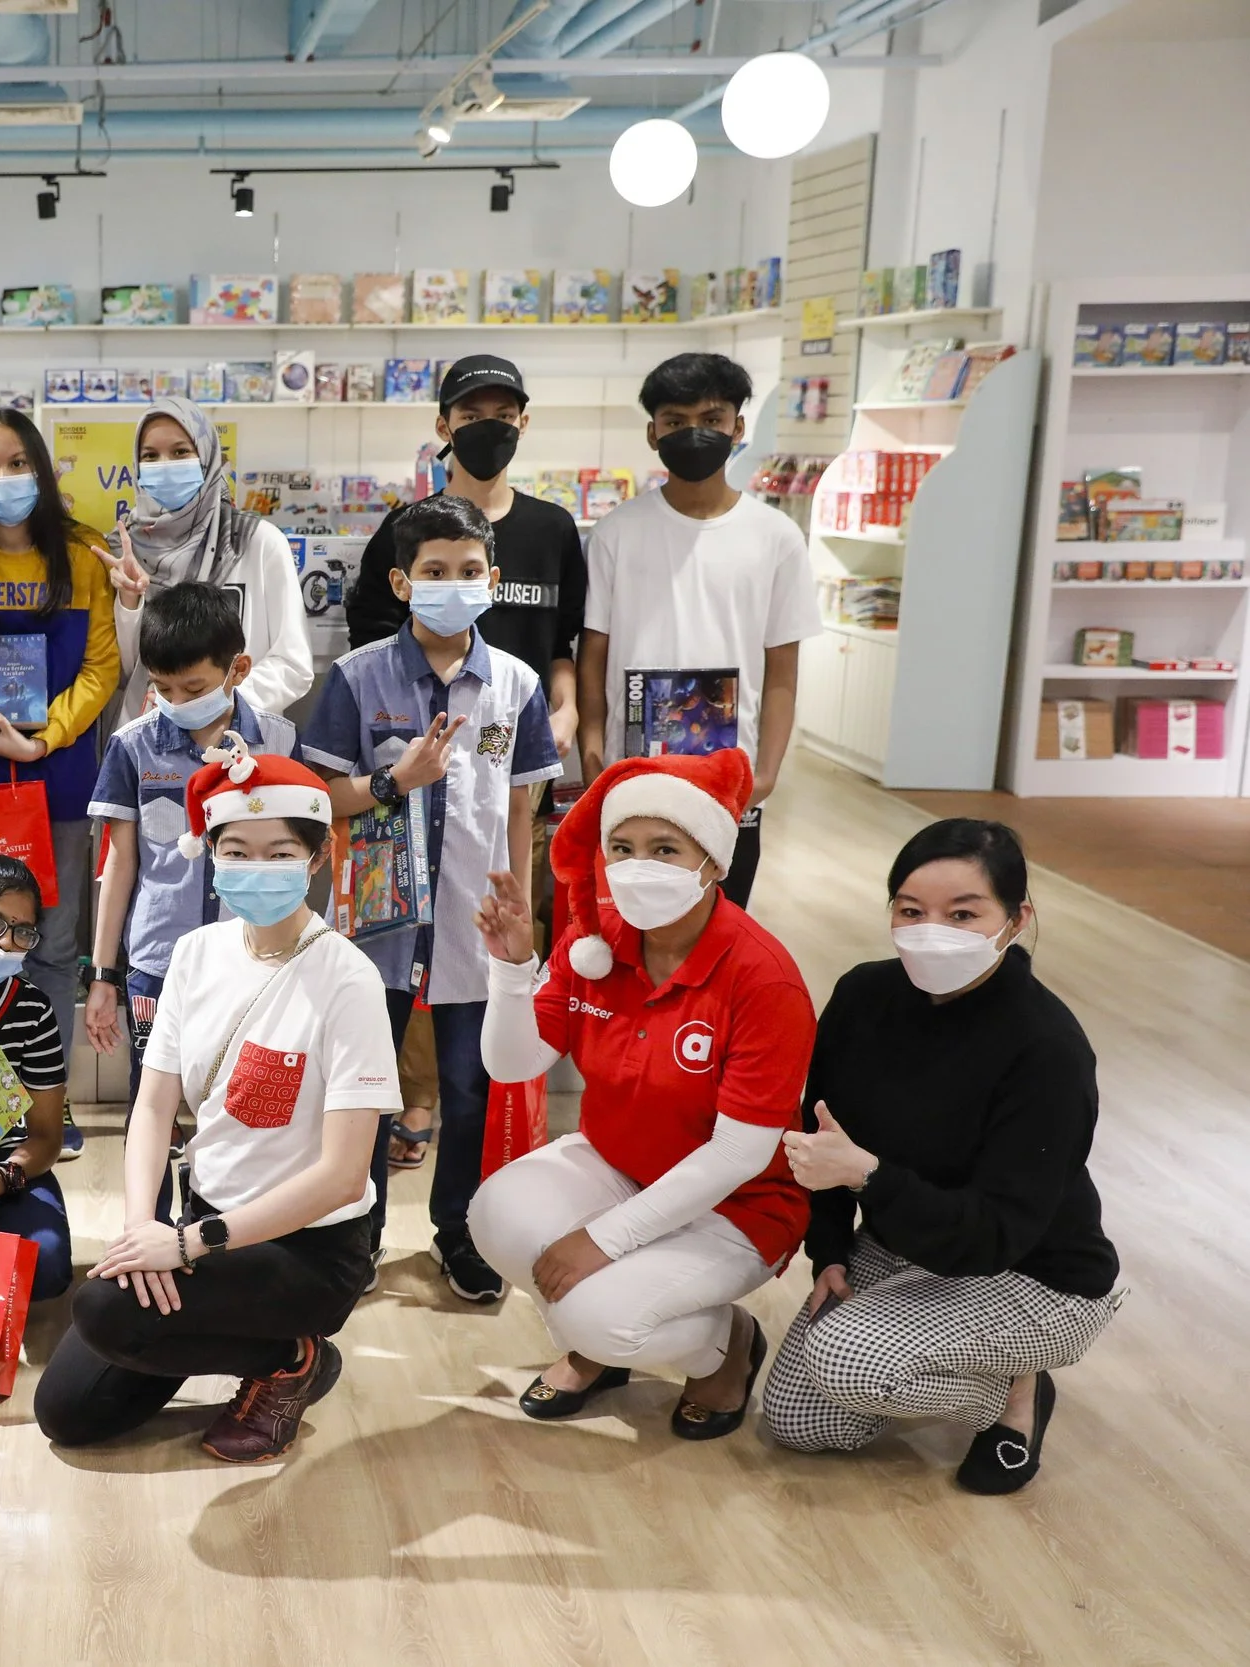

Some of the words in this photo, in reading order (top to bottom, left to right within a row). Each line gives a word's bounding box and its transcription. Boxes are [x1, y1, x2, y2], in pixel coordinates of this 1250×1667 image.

[98, 465, 133, 490] VA
[490, 582, 542, 605] CUSED
[629, 673, 644, 700] 100
[502, 1107, 514, 1166] FABER-CASTE
